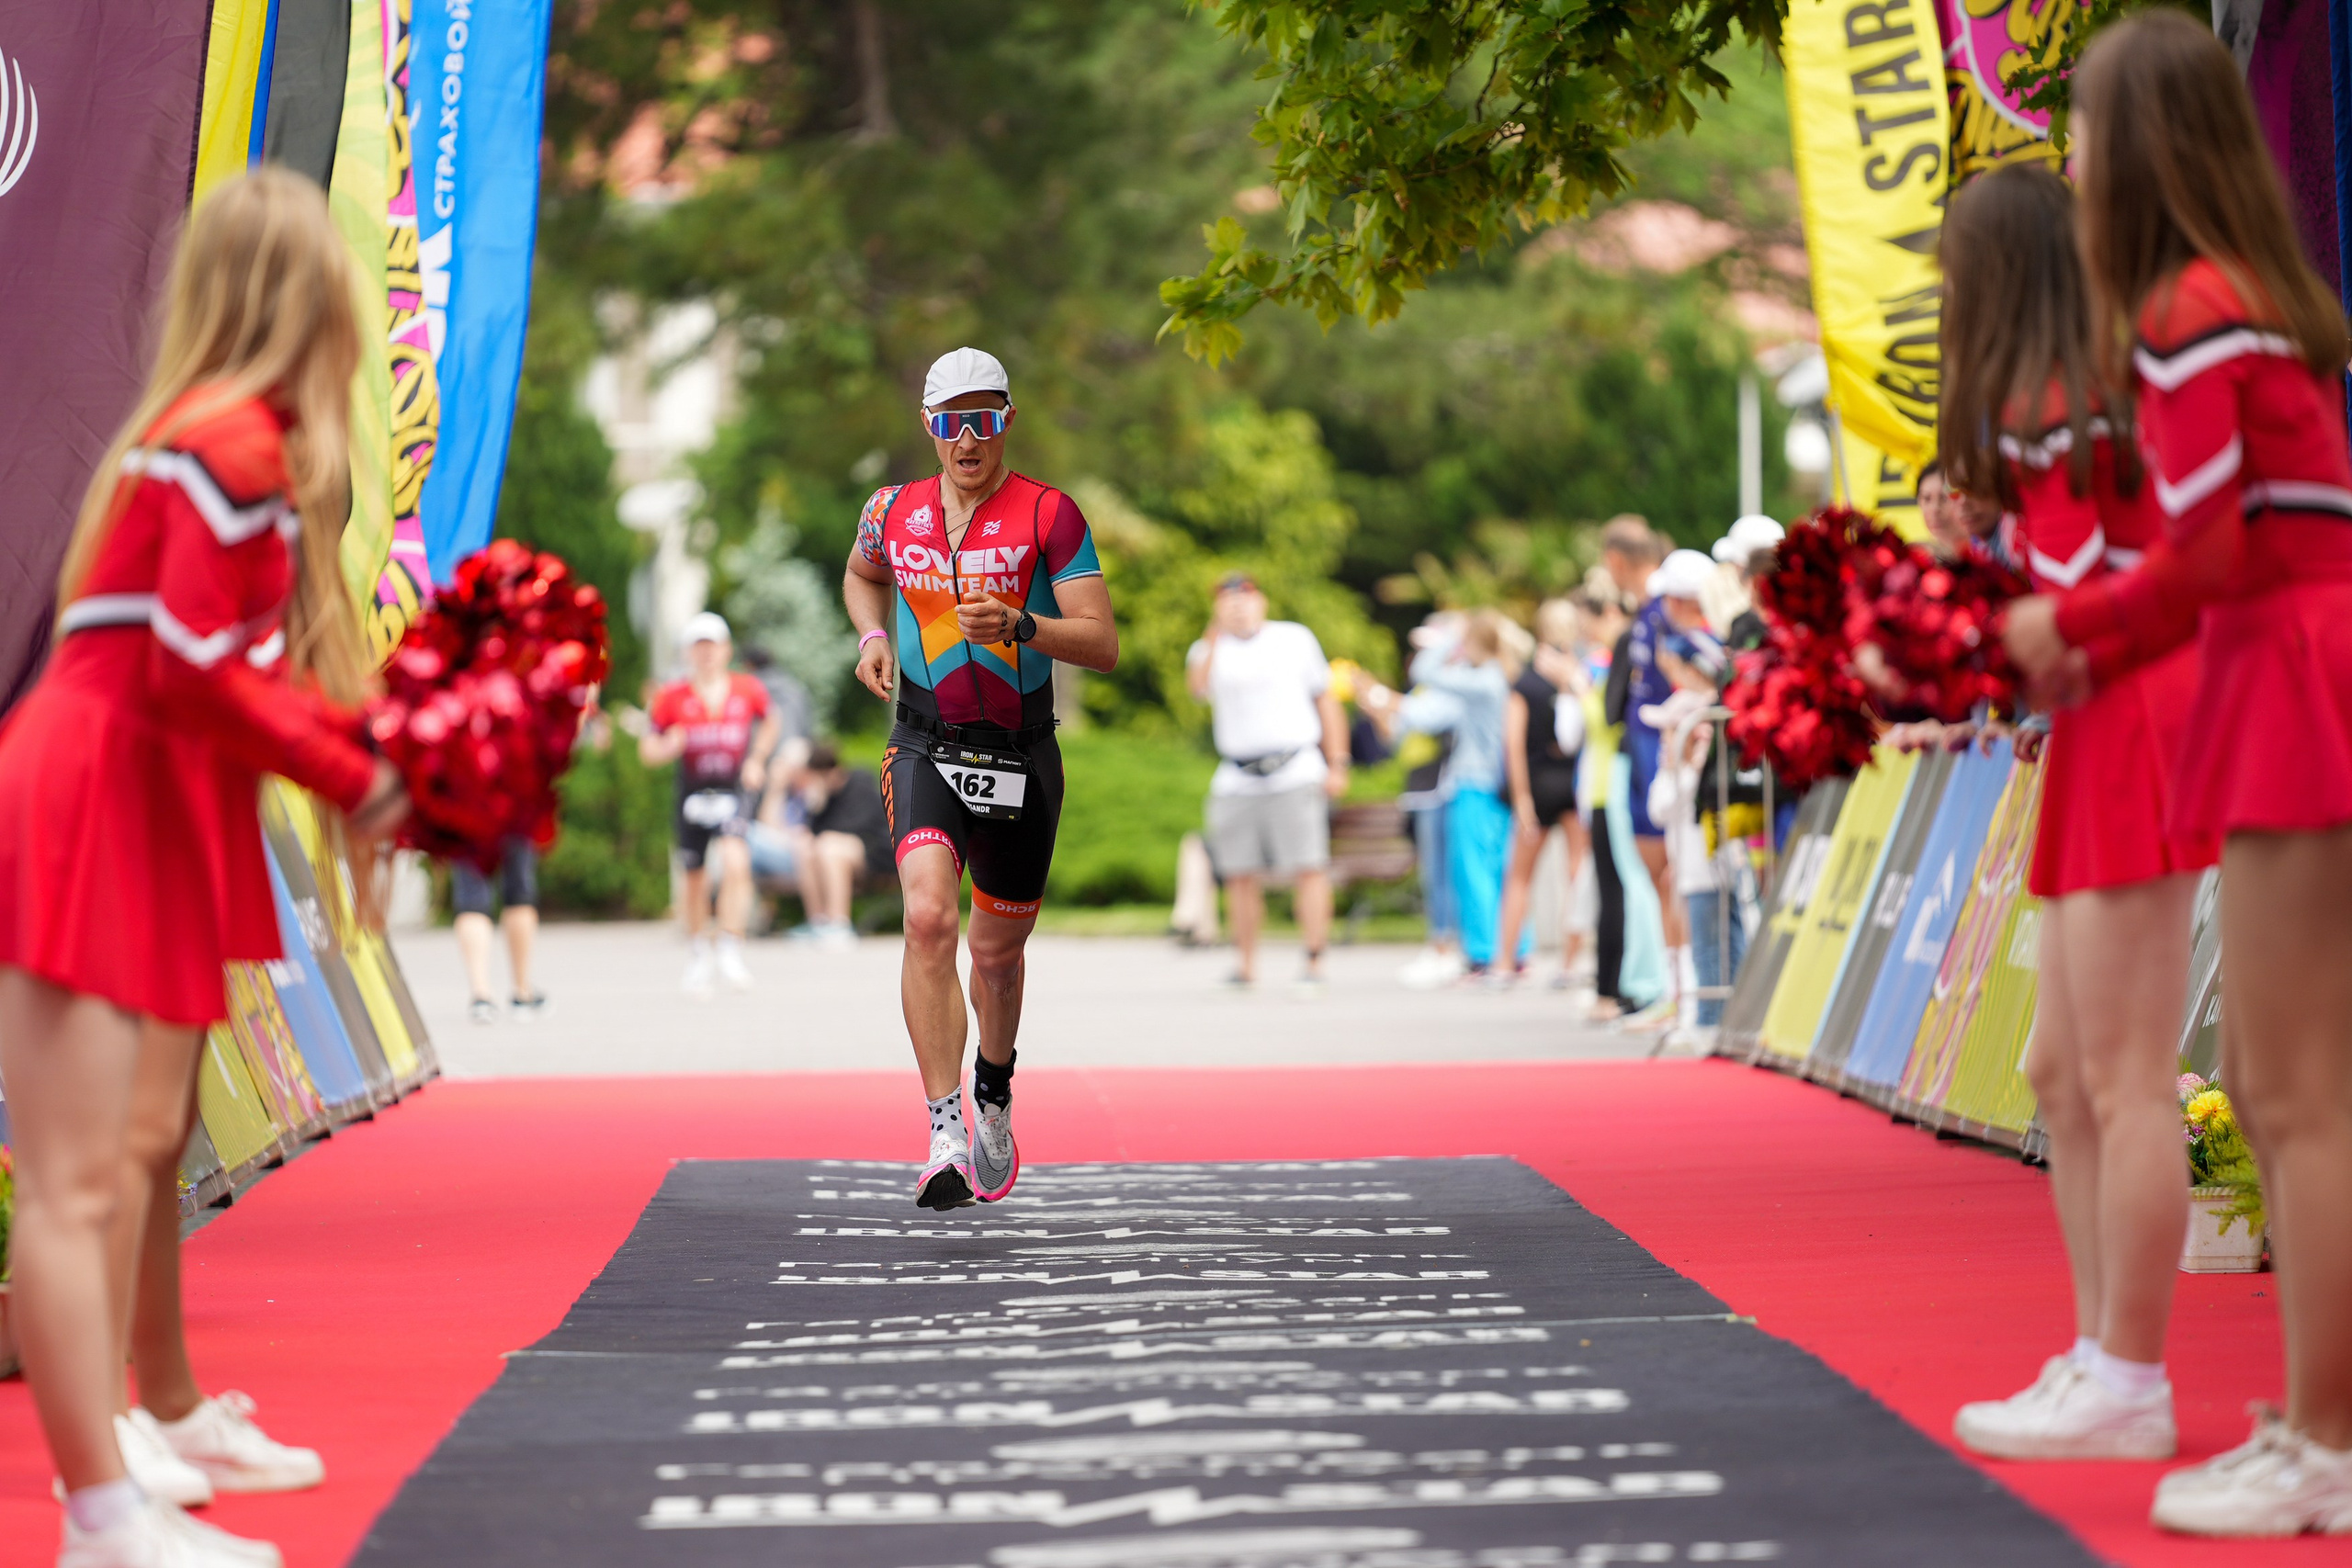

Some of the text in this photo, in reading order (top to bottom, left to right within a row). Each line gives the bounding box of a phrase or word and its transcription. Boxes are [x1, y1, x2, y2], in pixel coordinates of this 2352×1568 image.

[1844, 0, 1941, 193] STAR
[889, 540, 1030, 575] LOVELY
[978, 753, 993, 761] STAR
[950, 772, 996, 799] 162
